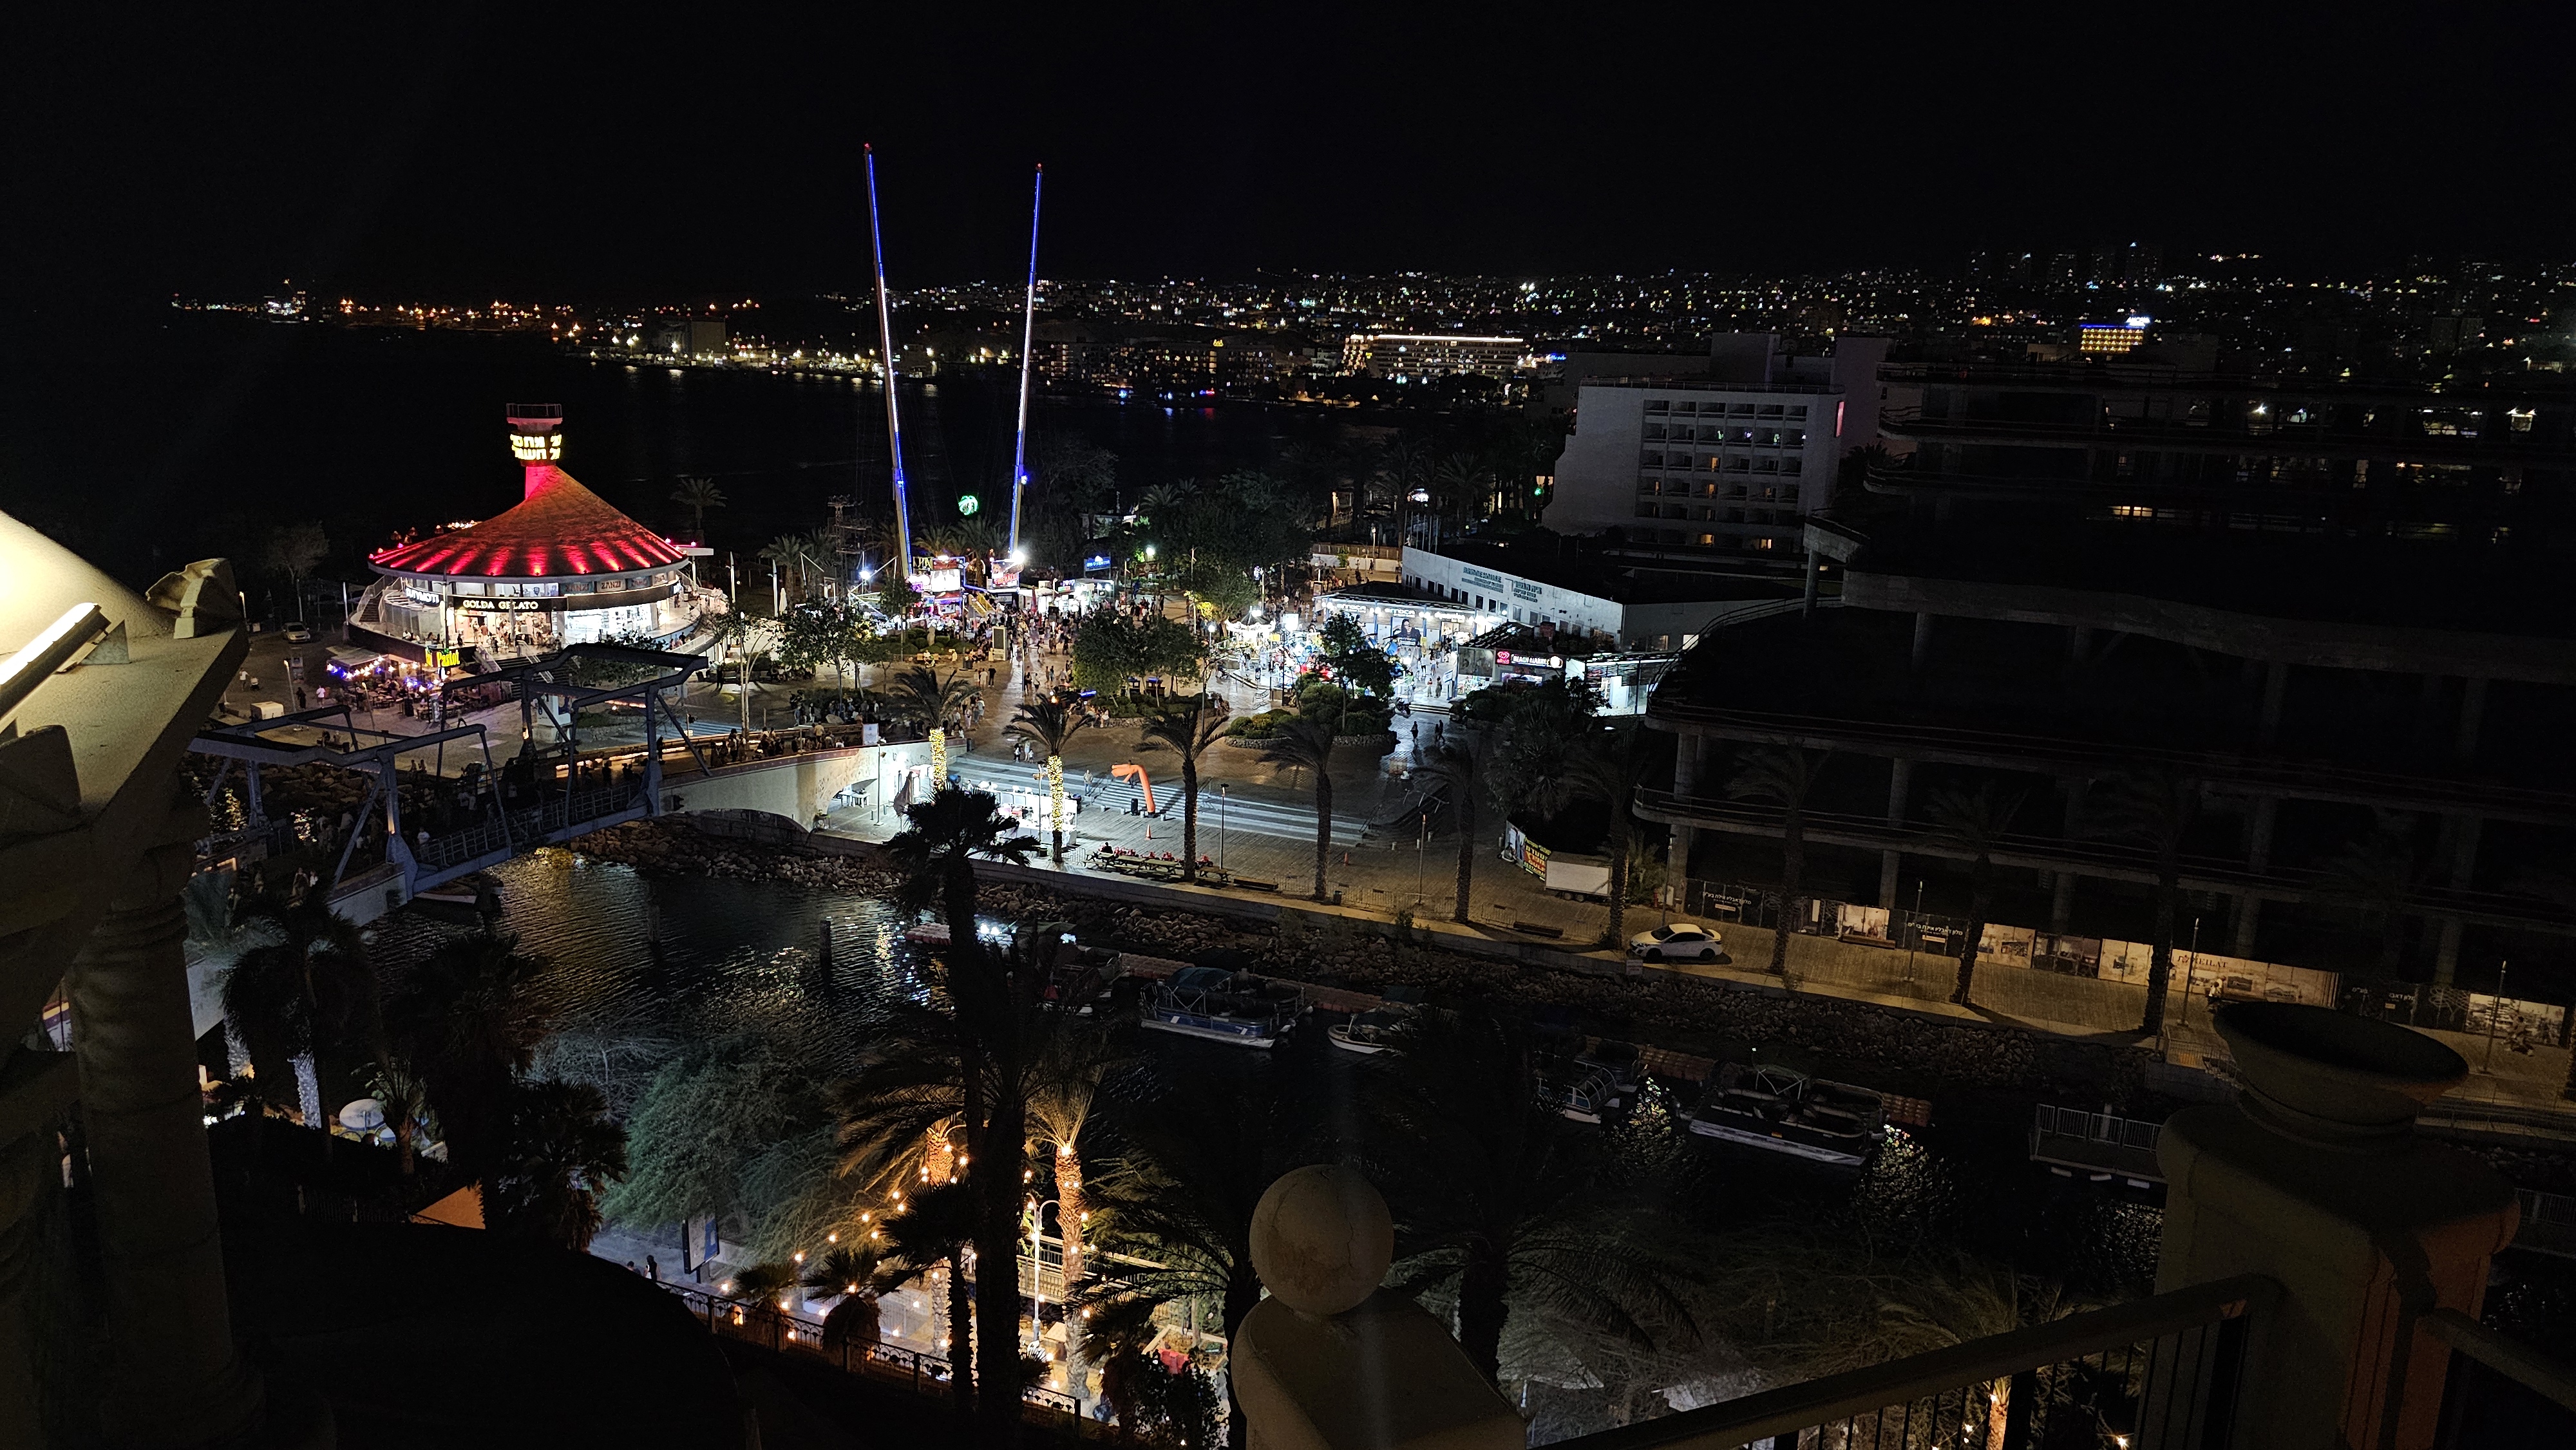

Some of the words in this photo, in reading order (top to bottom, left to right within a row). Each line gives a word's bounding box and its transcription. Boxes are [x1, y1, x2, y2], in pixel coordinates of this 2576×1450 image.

[601, 581, 621, 590] ZANZI
[462, 600, 495, 609] GOLDA
[498, 601, 539, 610] GELATO
